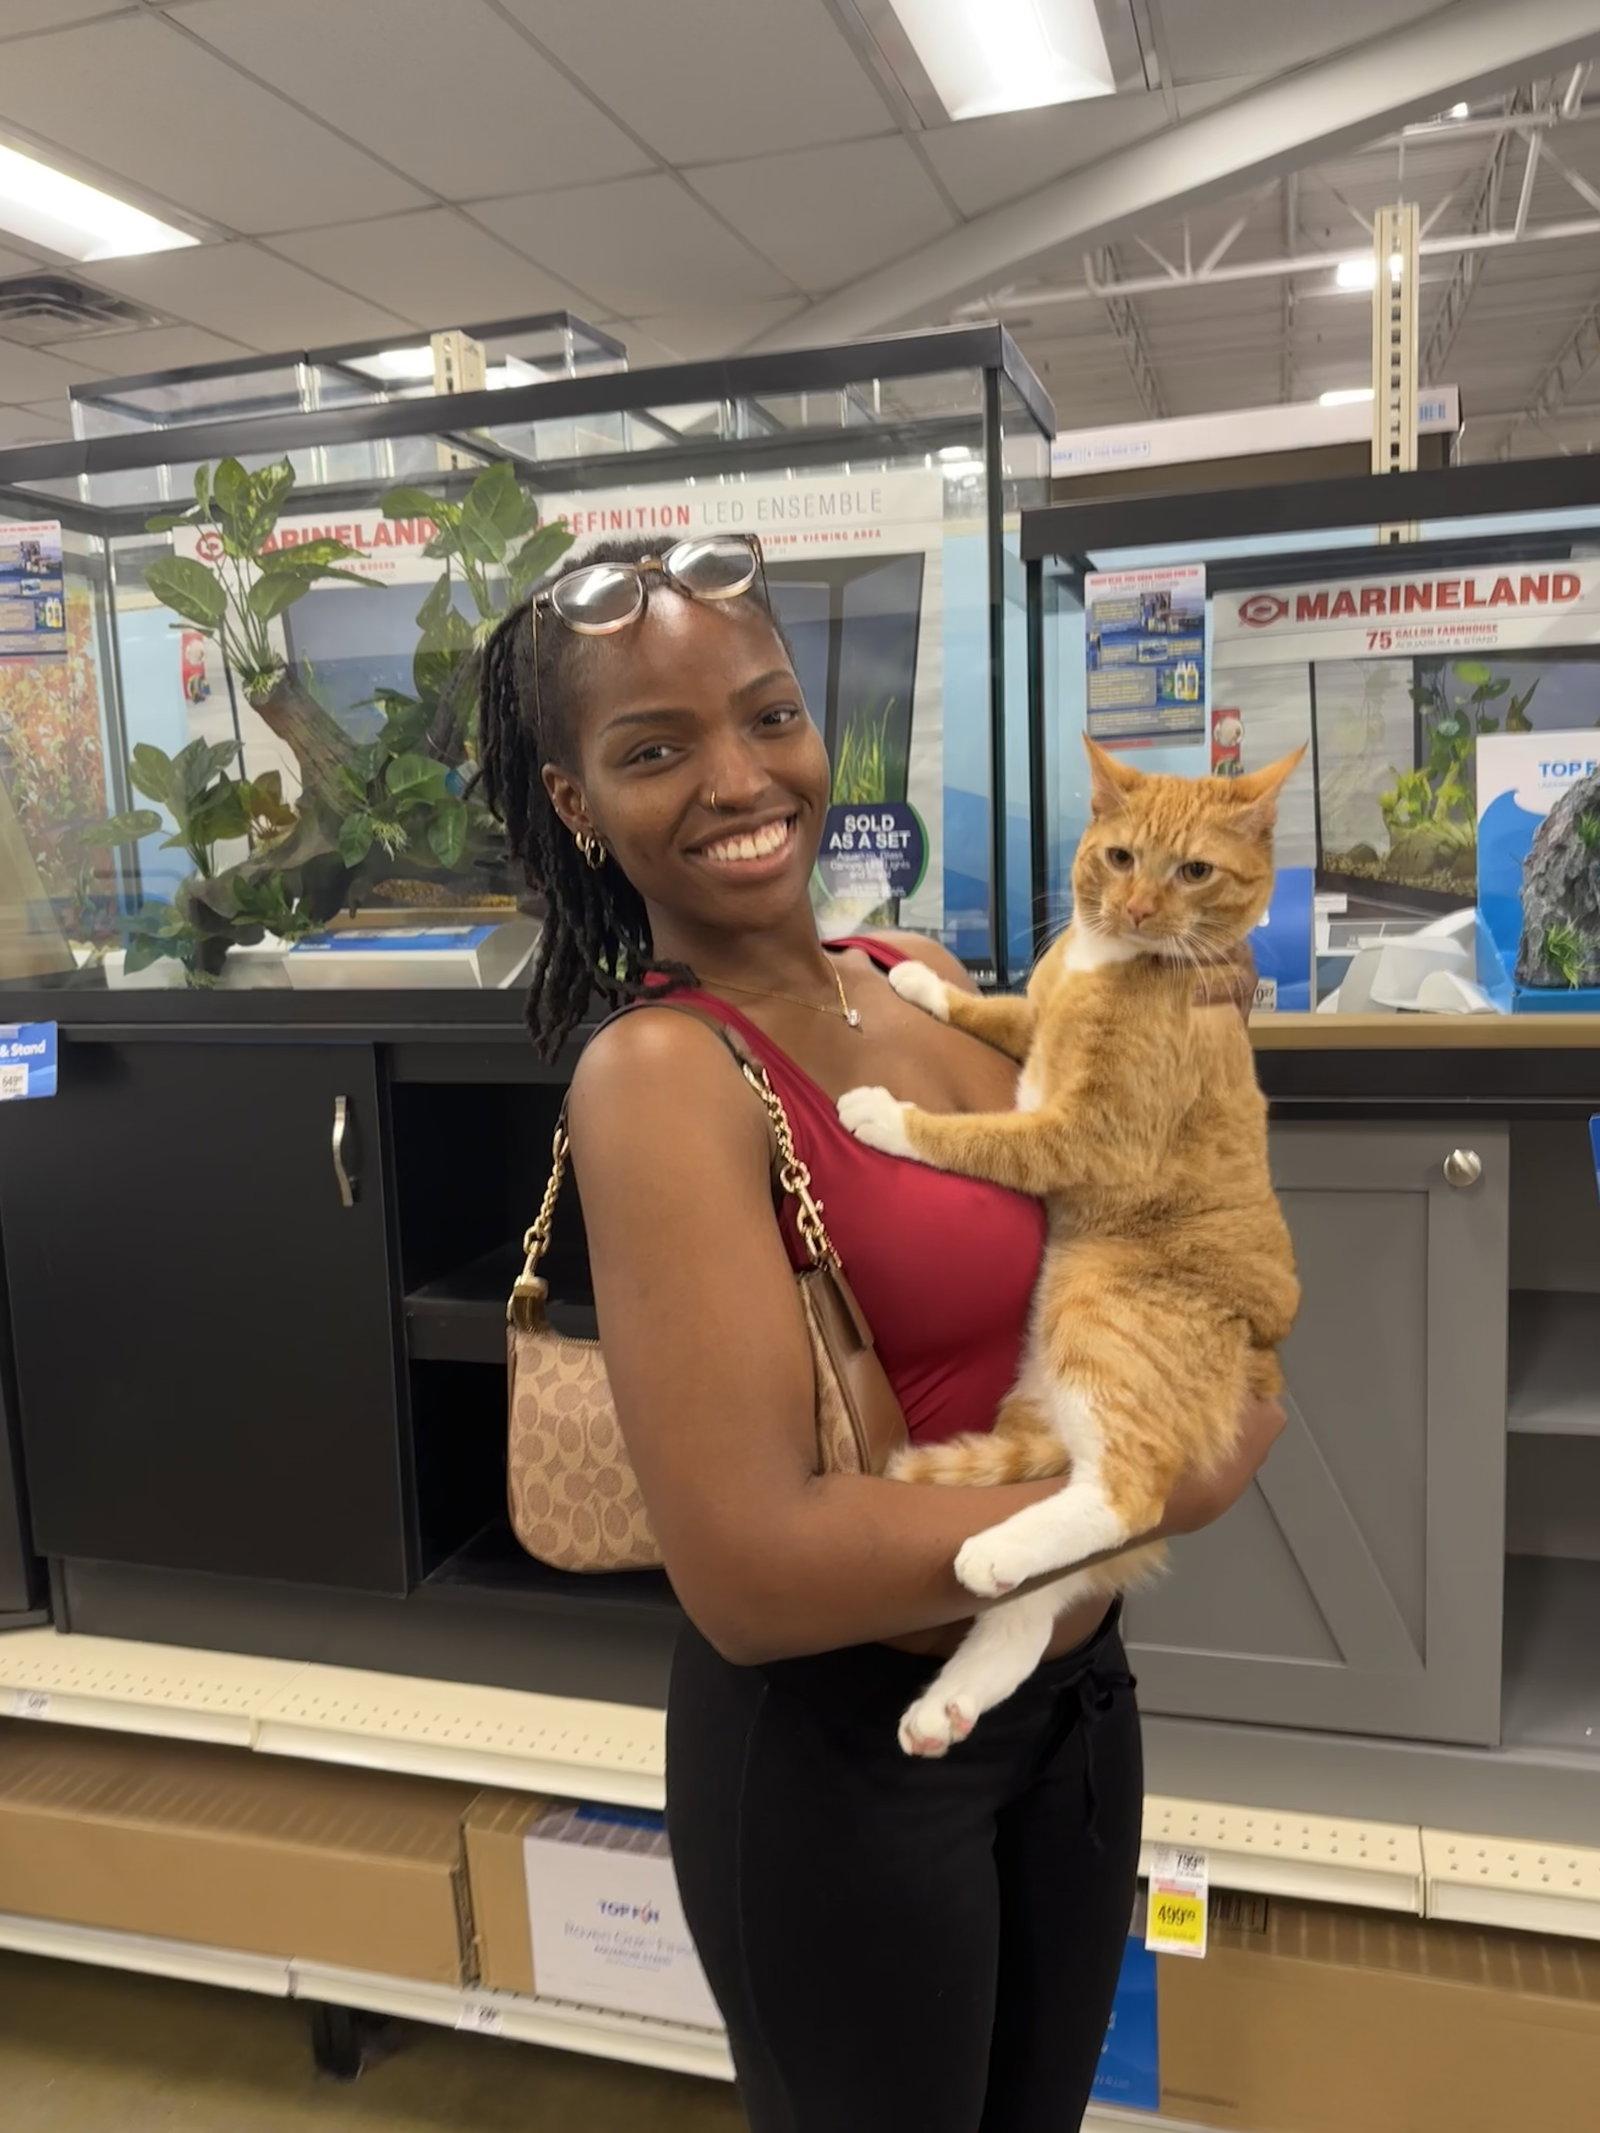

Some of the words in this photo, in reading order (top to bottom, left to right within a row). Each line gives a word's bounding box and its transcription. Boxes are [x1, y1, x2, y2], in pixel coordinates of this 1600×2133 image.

[702, 501, 745, 526] LED
[756, 489, 883, 521] ENSEMBLE
[261, 516, 440, 557] ARINELAND
[1296, 573, 1582, 623] MARINELAND
[1366, 628, 1393, 651] 75
[1395, 627, 1434, 640] GALLON
[1437, 622, 1498, 637] FARMHOUSE
[844, 814, 895, 833] SOLD
[829, 831, 854, 850] AS
[858, 831, 871, 849] A
[875, 830, 911, 849] SET
[10, 1039, 46, 1057] Stand
